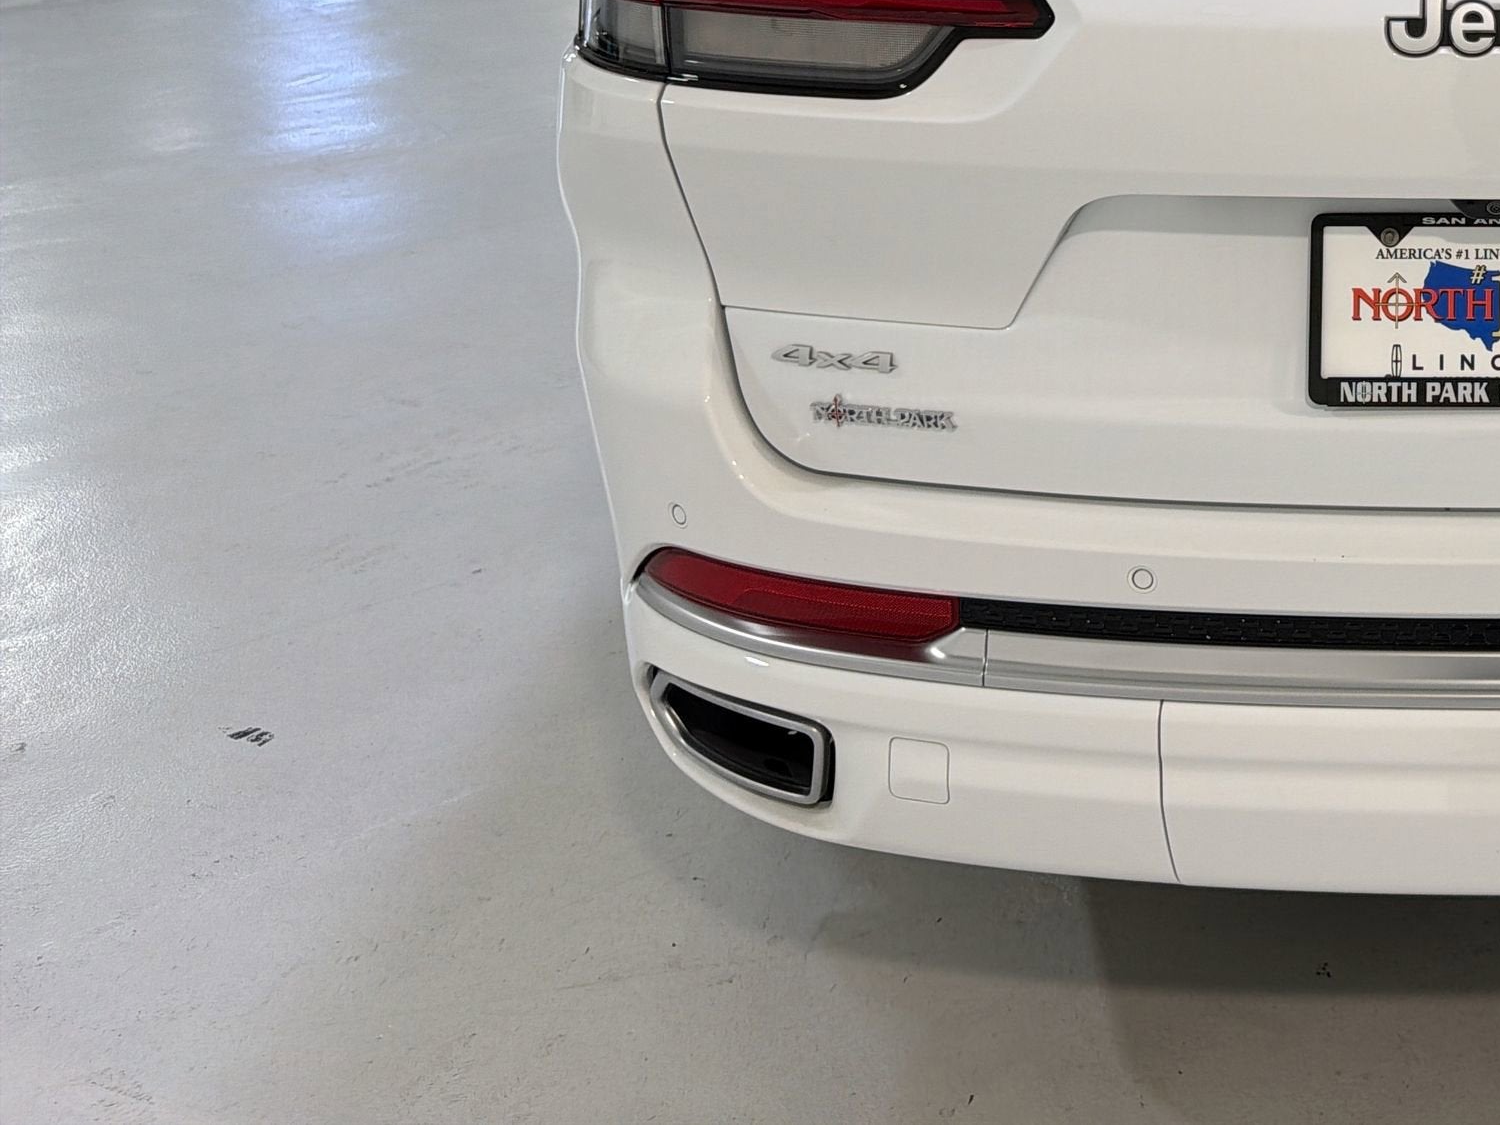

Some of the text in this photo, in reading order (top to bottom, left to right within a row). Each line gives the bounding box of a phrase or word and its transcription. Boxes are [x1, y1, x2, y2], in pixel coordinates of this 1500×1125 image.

[1422, 217, 1466, 225] SAN
[1375, 248, 1452, 260] AMERICA'S
[1455, 248, 1470, 260] #1
[1351, 287, 1495, 322] NORTH
[771, 344, 898, 374] 4x4
[1339, 381, 1418, 404] NORTH
[1425, 382, 1490, 403] PARK
[811, 402, 958, 431] NORTH PARK
